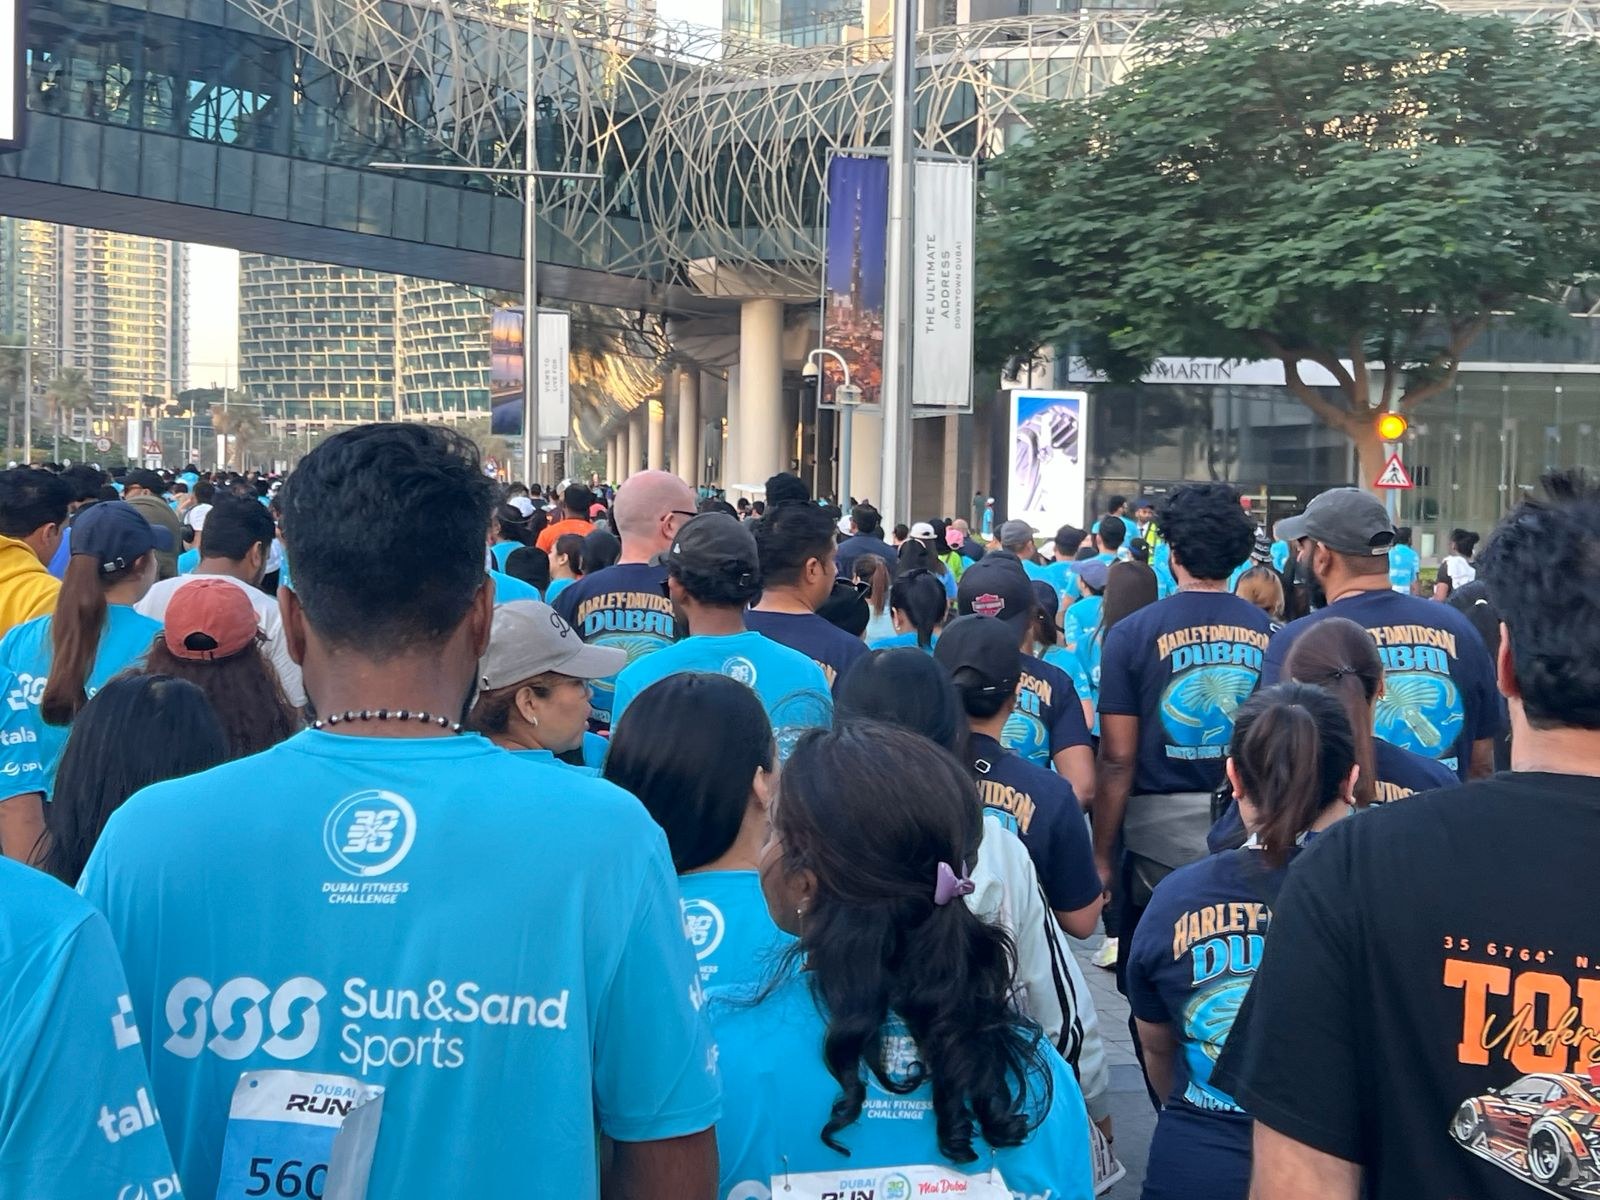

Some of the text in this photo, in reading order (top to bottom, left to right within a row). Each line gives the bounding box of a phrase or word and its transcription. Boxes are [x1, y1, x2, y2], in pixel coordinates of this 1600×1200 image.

[926, 234, 936, 333] THE ULTIMATE
[941, 250, 950, 318] ADDRESS
[1156, 363, 1232, 380] MARTIN
[584, 610, 674, 638] DUBAI
[1171, 642, 1263, 673] DUBAI
[322, 882, 410, 893] DUBAI FITNESS
[328, 893, 399, 904] CHALLENGE
[340, 976, 569, 1030] Sun&Sand
[340, 1023, 465, 1075] Sports
[313, 1083, 357, 1099] DUBAI
[97, 1087, 160, 1143] tal
[285, 1093, 353, 1117] RUN
[862, 1100, 934, 1110] DUBAI FITNESS
[867, 1110, 925, 1120] CHALLENGE
[839, 1178, 876, 1190] DUBAI
